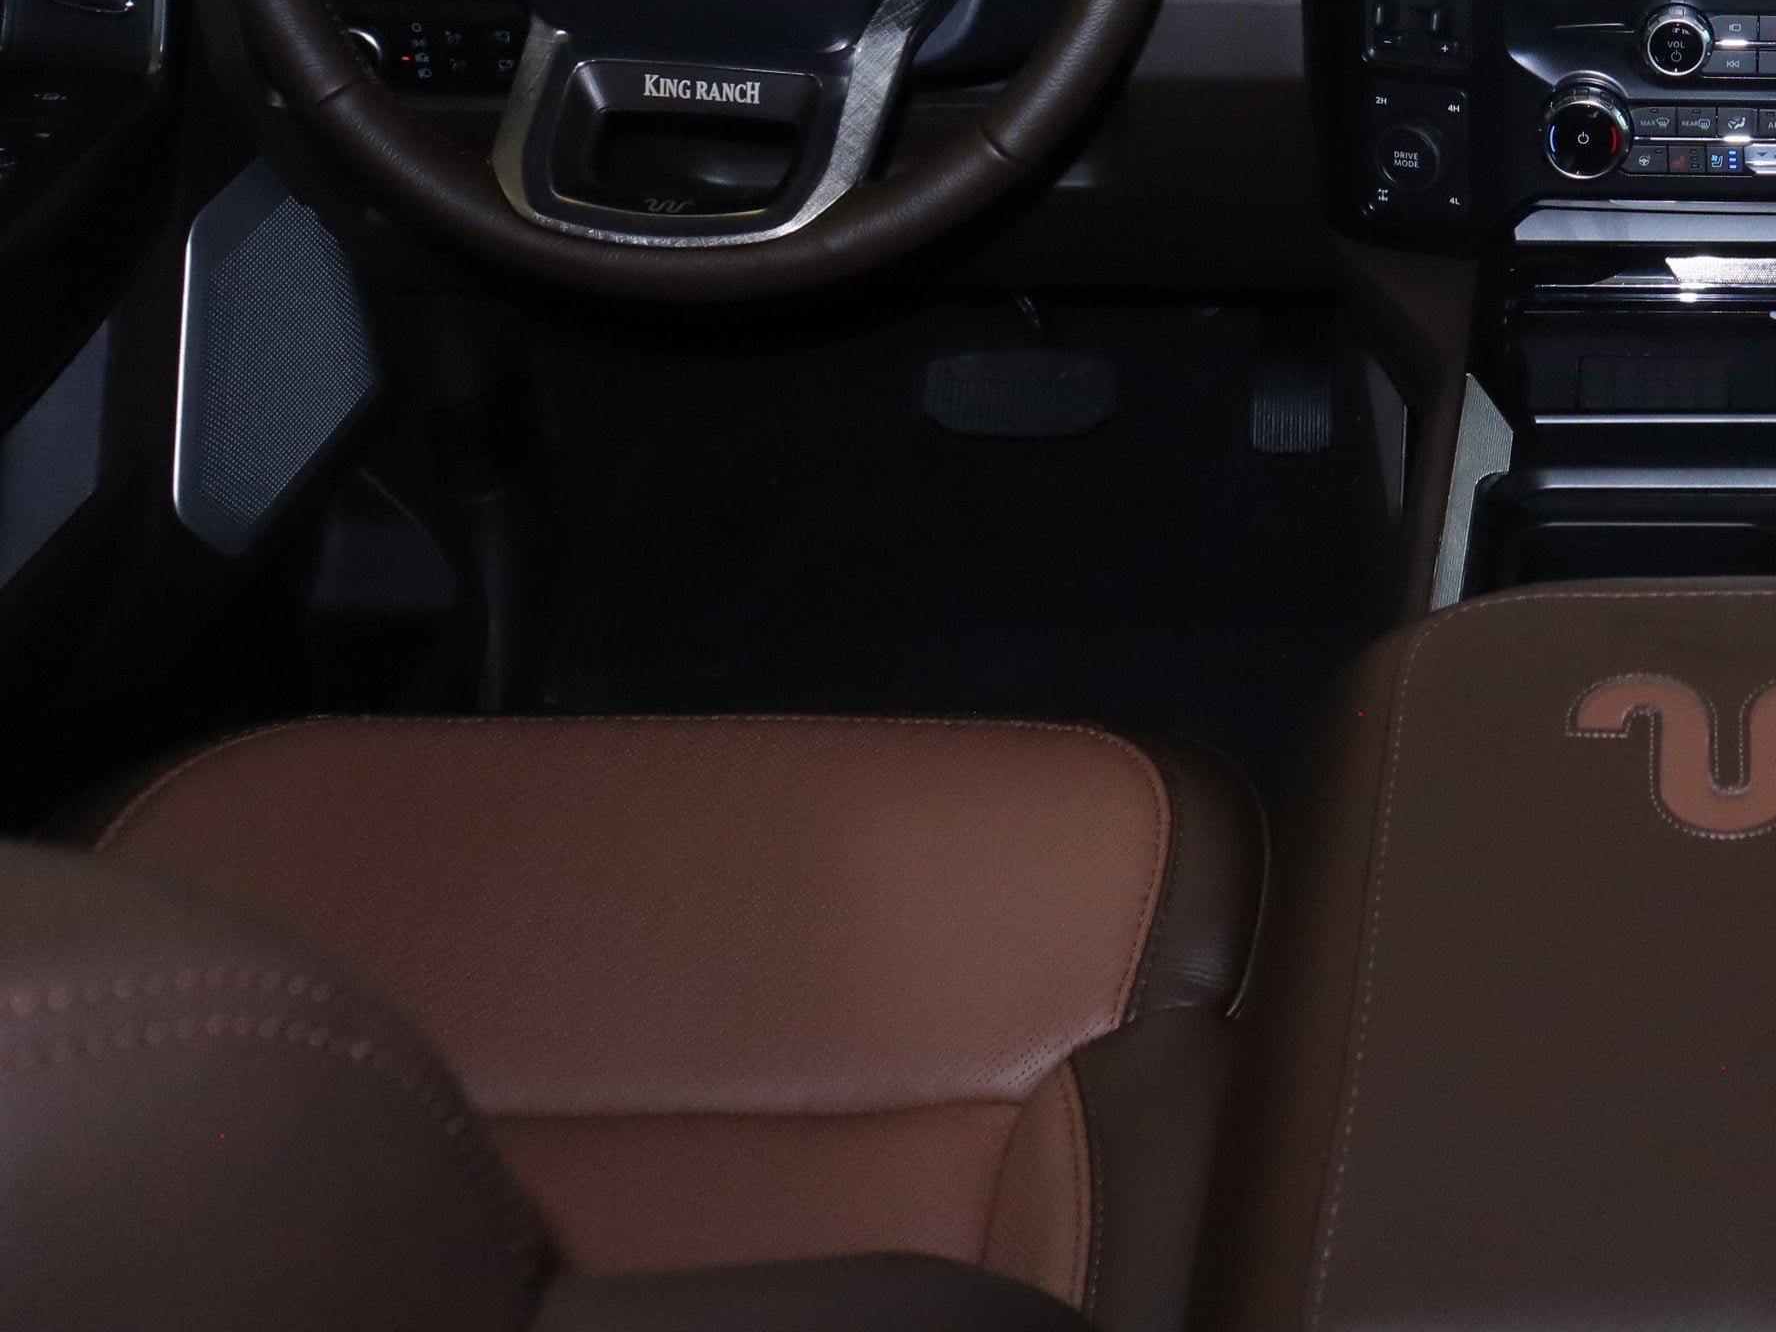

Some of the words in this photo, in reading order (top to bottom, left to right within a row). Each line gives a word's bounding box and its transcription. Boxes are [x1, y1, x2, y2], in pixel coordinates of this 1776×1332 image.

[1666, 40, 1685, 49] VOL
[643, 73, 691, 100] KING
[695, 80, 761, 105] RANCH
[1375, 96, 1388, 105] 2H
[1447, 103, 1461, 113] 4H
[1640, 119, 1656, 127] MAX
[1681, 119, 1699, 127] REAR
[1393, 150, 1419, 160] DRIVE
[1394, 159, 1420, 169] MODE
[1449, 196, 1461, 206] 4L
